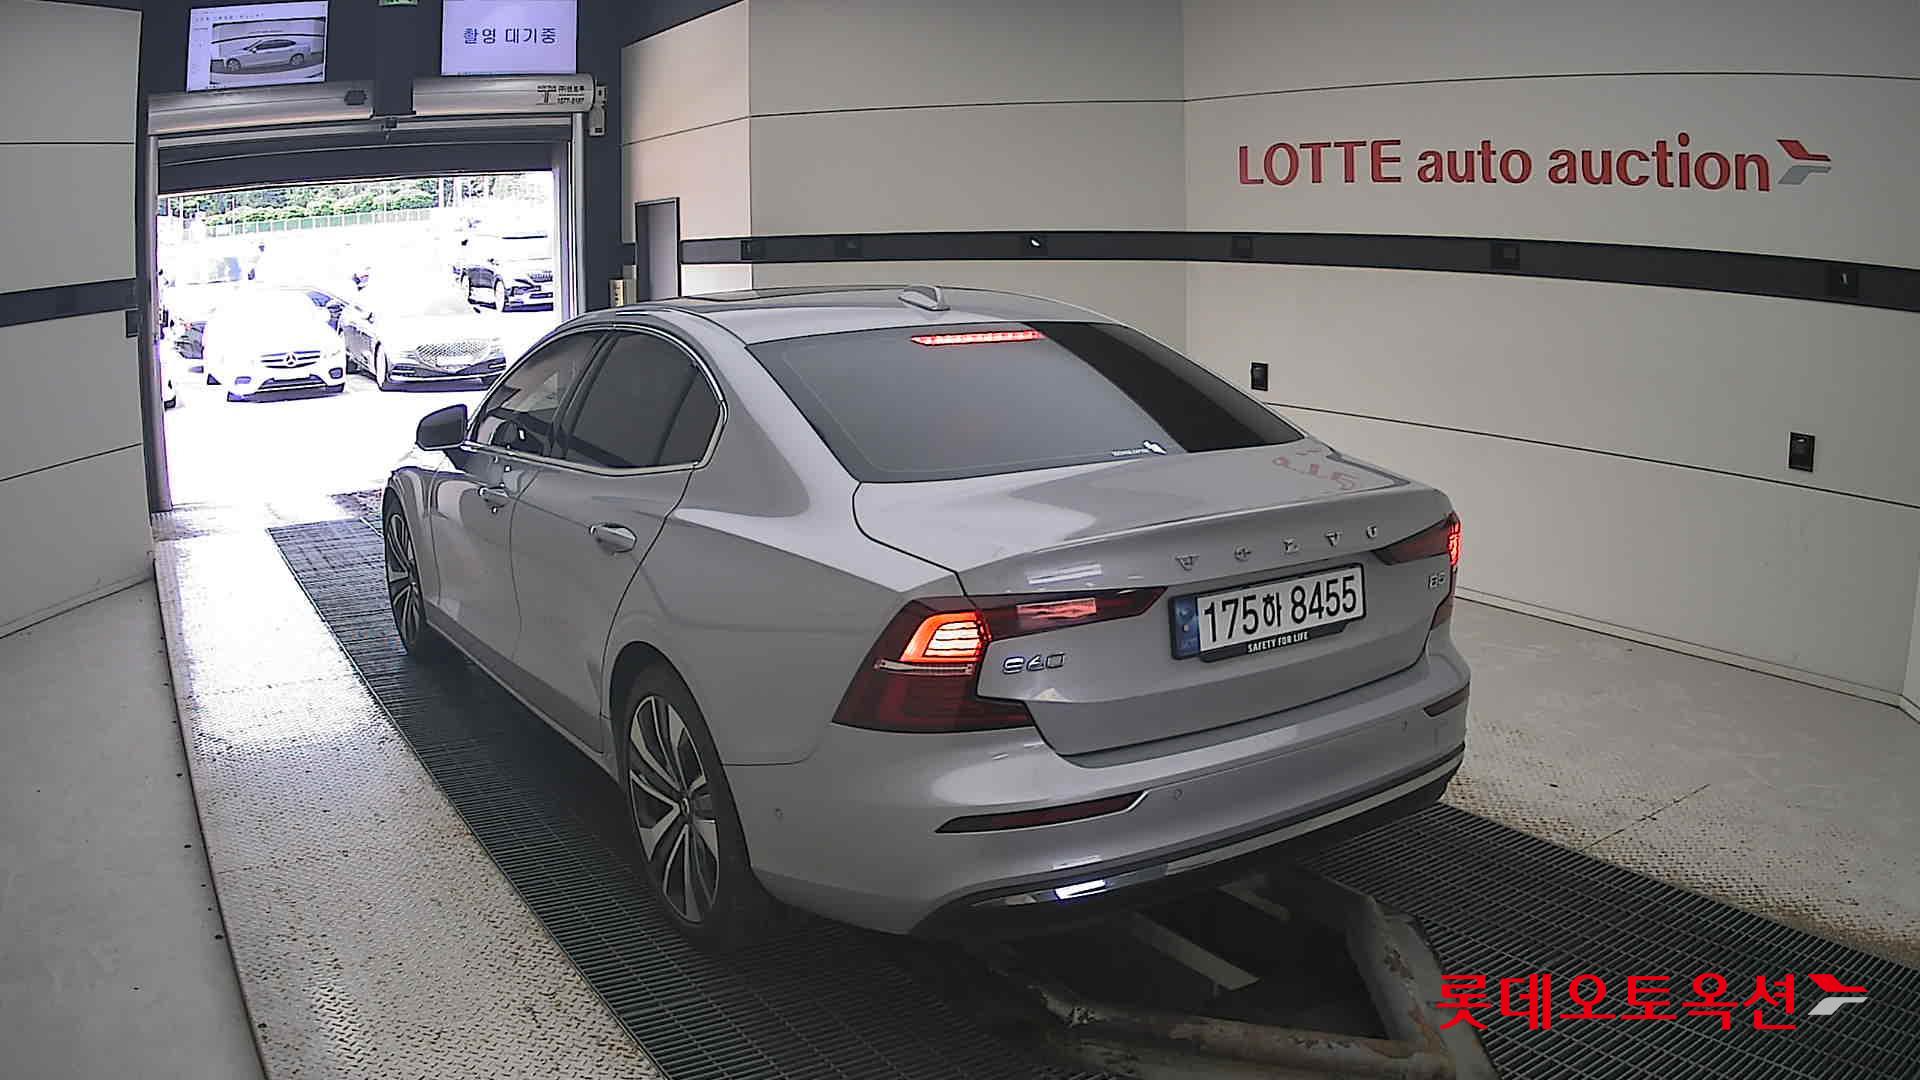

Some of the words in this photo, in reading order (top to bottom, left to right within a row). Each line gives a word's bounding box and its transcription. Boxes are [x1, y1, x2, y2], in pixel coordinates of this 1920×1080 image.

[463, 27, 497, 44] 촬영
[504, 27, 557, 45] 대기중
[1238, 139, 1401, 186] LOTTE
[1416, 139, 1532, 185] auto
[1547, 131, 1770, 192] auction
[1203, 591, 1282, 643] 175하
[1290, 575, 1357, 625] 8455
[1247, 639, 1276, 653] SAFETY
[1277, 635, 1293, 646] FOR
[1293, 631, 1309, 642] LIFE
